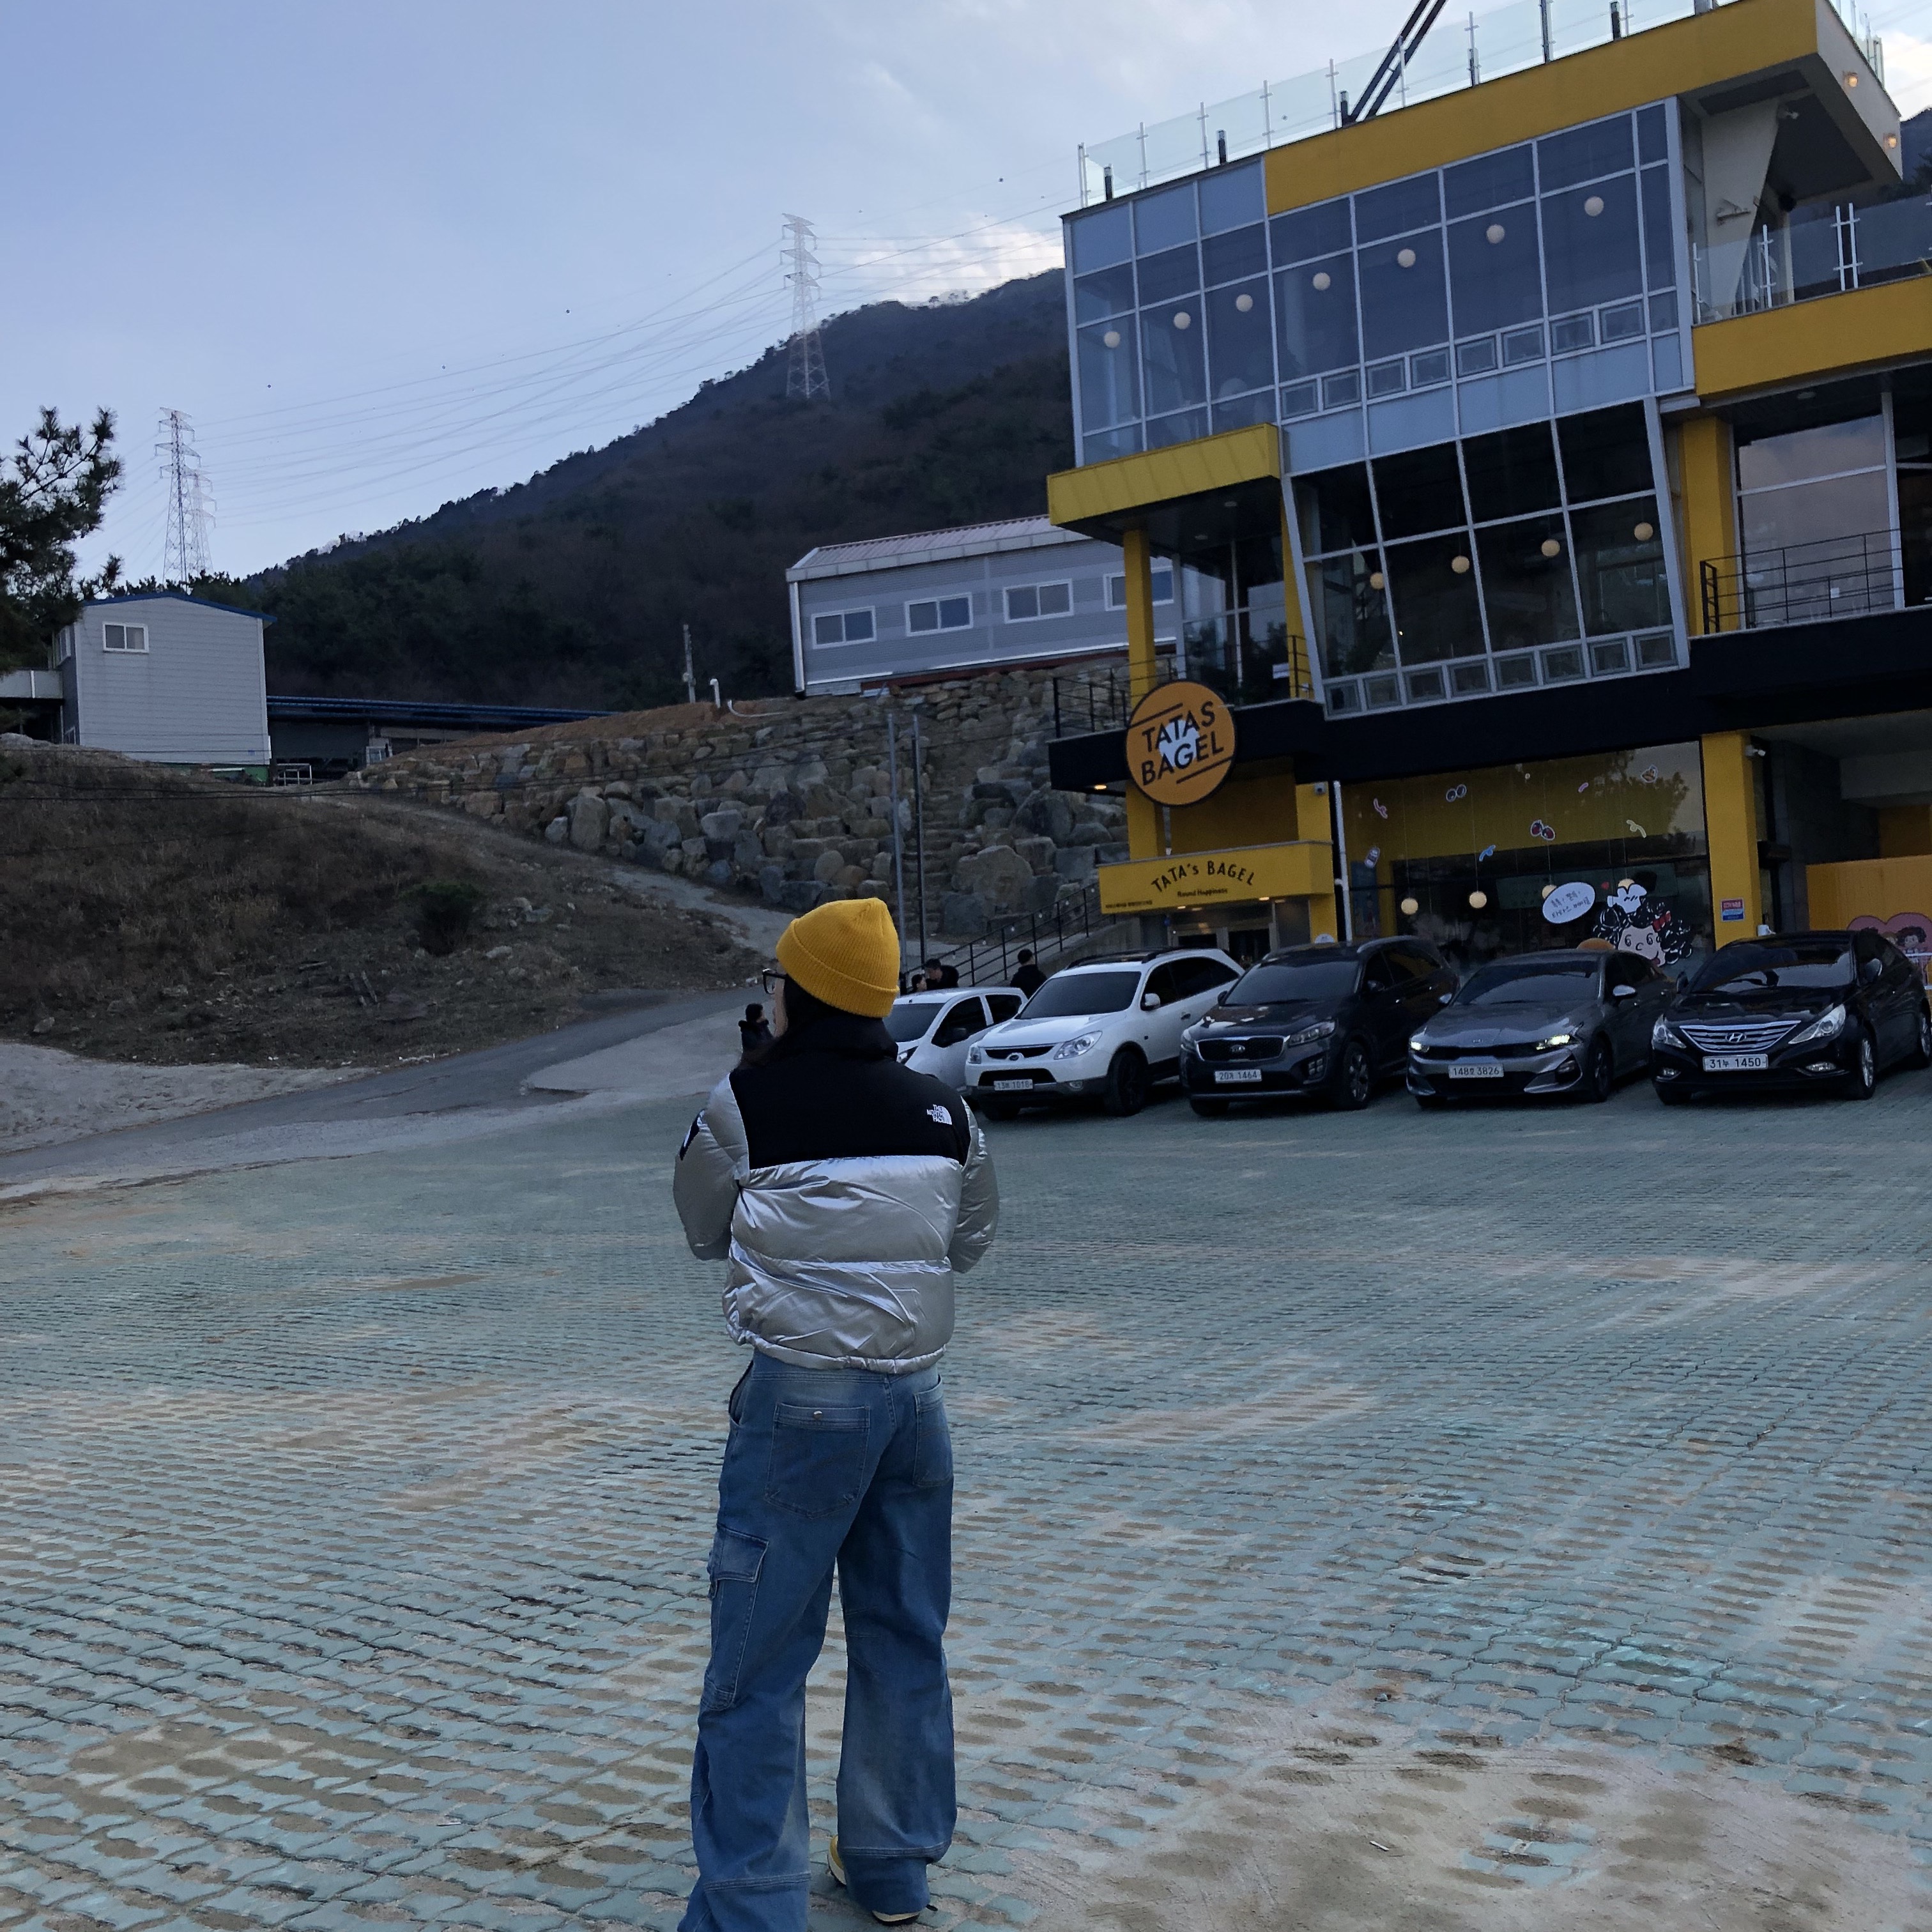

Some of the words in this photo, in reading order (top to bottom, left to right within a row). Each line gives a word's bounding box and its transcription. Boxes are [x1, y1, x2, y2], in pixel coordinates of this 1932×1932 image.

[1142, 700, 1215, 753] TATAS
[1141, 731, 1224, 786] BAGEL
[1207, 859, 1255, 886] BAGEL
[1476, 1066, 1499, 1076] 3826
[1735, 1057, 1761, 1068] 1450
